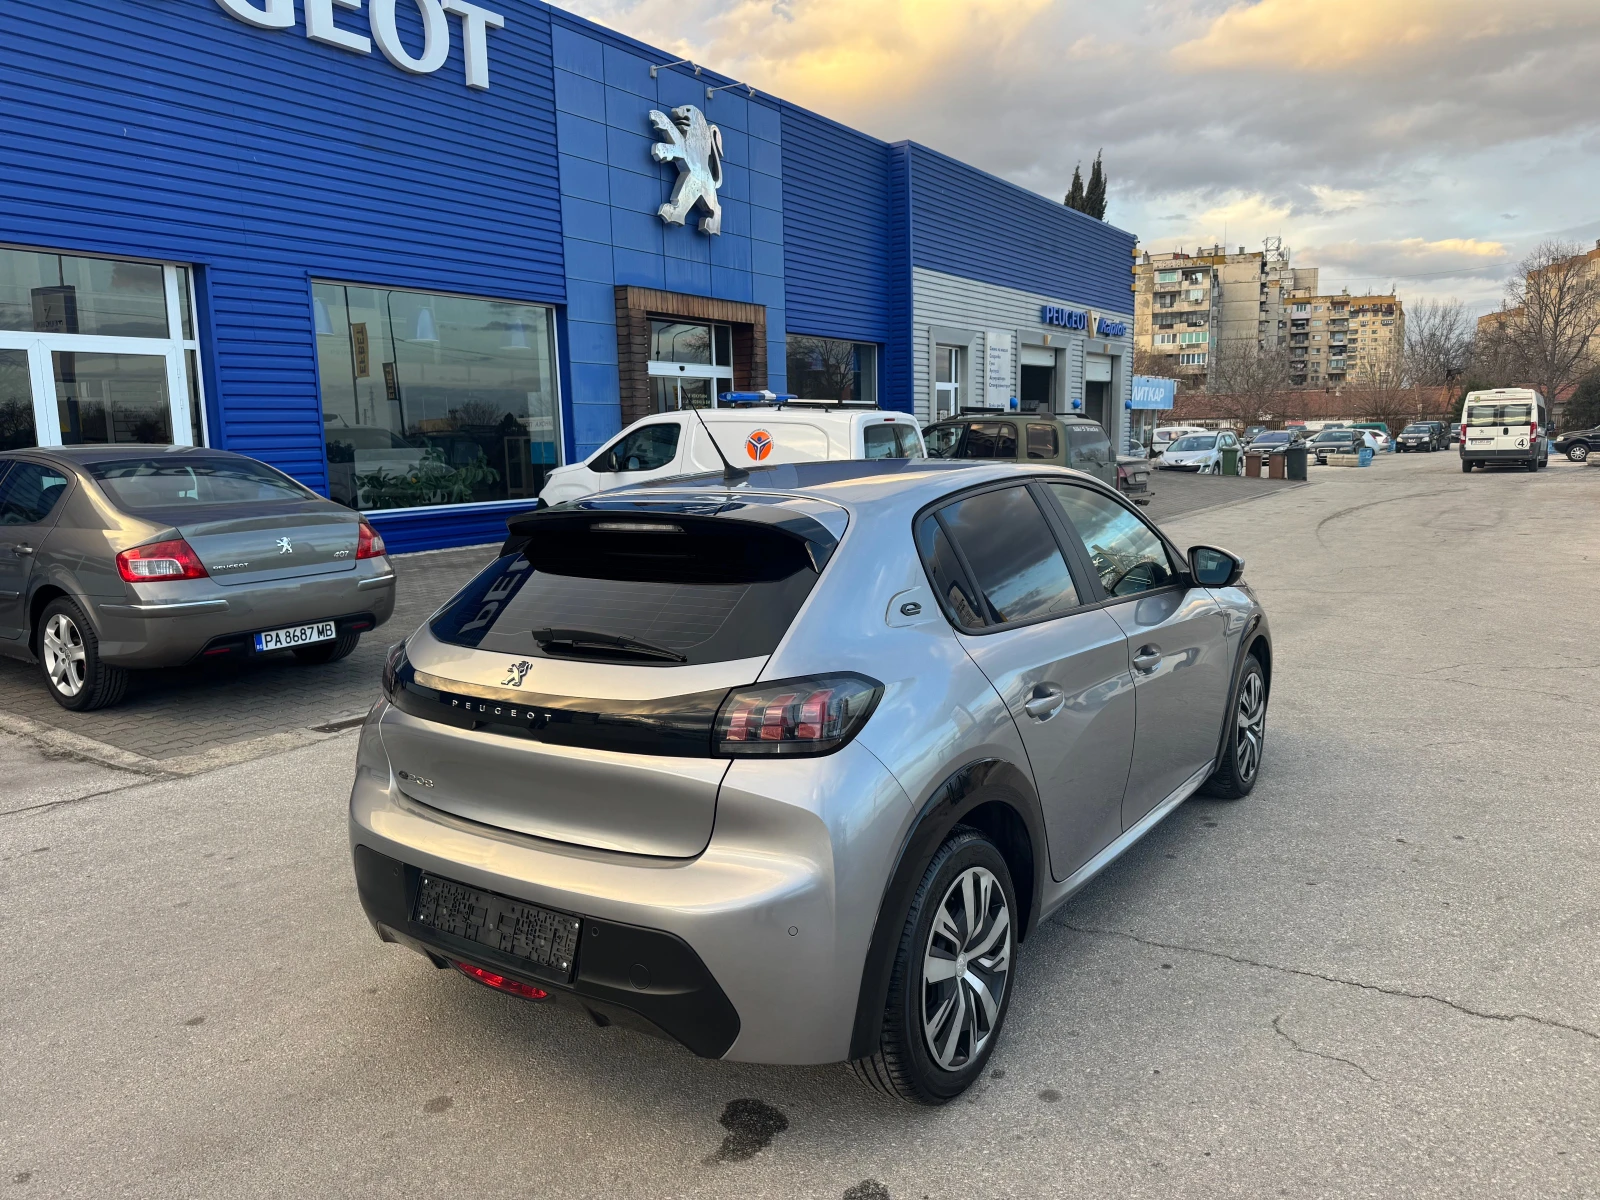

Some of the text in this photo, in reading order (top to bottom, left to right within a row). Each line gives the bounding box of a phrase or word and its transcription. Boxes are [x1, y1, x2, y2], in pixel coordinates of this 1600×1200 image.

[213, 0, 505, 89] EOT
[1046, 305, 1088, 331] PEUGEOT
[1517, 439, 1525, 447] 4
[333, 550, 349, 558] 407
[212, 562, 249, 571] PEUGEOT
[264, 632, 283, 648] PA
[284, 626, 314, 644] 8687
[316, 623, 333, 638] MB
[452, 699, 552, 722] PEUGEOT
